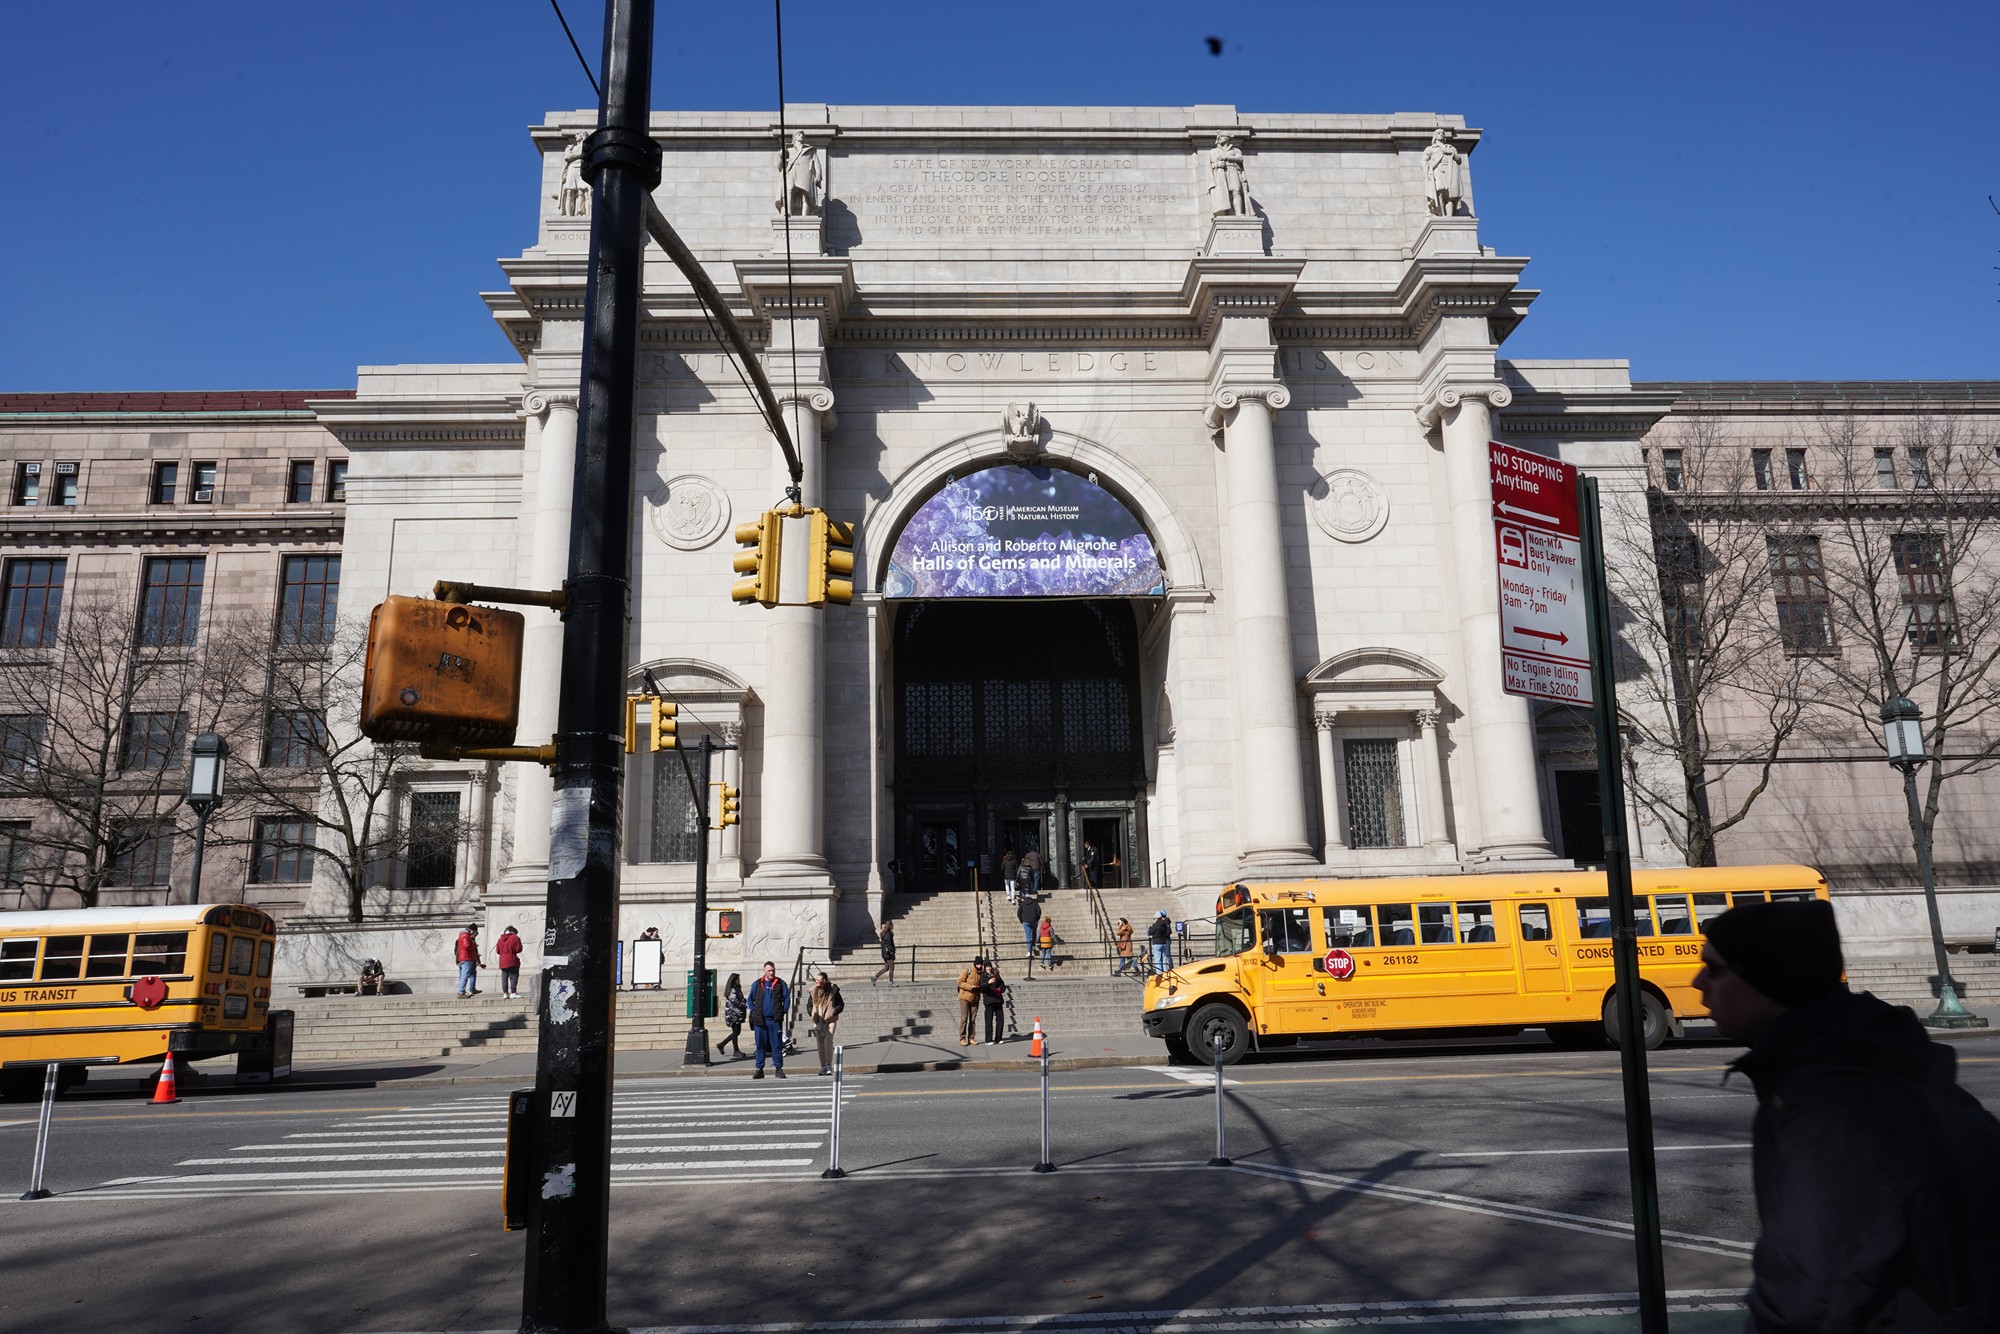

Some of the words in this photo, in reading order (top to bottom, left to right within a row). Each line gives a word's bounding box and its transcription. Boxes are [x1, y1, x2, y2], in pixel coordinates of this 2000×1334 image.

[893, 160, 932, 169] STATE
[939, 160, 954, 169] OF
[961, 160, 990, 169] NEW
[997, 160, 1032, 169] YORK
[1039, 160, 1110, 169] MEMORIAL
[1114, 160, 1132, 169] TO
[922, 171, 1009, 182] THEODORE
[1015, 171, 1104, 182] ROOSEVELT
[877, 185, 884, 193] A
[890, 185, 928, 193] GREAT
[934, 185, 976, 193] LEADER
[984, 185, 998, 193] OF
[1004, 185, 1026, 193] THE
[1032, 185, 1072, 193] YOUTH
[1078, 185, 1092, 193] OF
[1097, 185, 1149, 193] AMERICA
[850, 195, 861, 203] IN
[866, 195, 909, 203] ENERGY
[912, 195, 936, 203] AND
[941, 195, 1002, 203] FORTITUDE
[1008, 195, 1018, 203] IN
[1024, 195, 1044, 203] THE
[1048, 195, 1079, 203] FAITH
[1084, 195, 1098, 203] OF
[1103, 195, 1125, 203] OUR
[1131, 195, 1177, 203] FATHERS
[885, 205, 897, 214] IN
[904, 205, 953, 214] DEFENSE
[958, 205, 973, 214] OF
[978, 205, 1000, 214] THE
[1006, 205, 1048, 214] RIGHTS
[1054, 205, 1067, 214] OF
[1073, 205, 1095, 214] THE
[1101, 205, 1142, 214] PEOPLE
[875, 216, 887, 224] IN
[893, 216, 915, 224] THE
[921, 216, 951, 224] LOVE
[956, 216, 981, 224] AND
[987, 216, 1079, 224] CONSERVATION
[1085, 216, 1099, 224] OF
[1106, 216, 1153, 224] NATURE
[897, 226, 923, 235] AND
[928, 226, 943, 235] OF
[949, 226, 971, 235] THE
[977, 226, 1004, 235] BEST
[1009, 226, 1021, 235] IN
[1028, 226, 1051, 235] LIFE
[1056, 226, 1082, 235] AND
[1087, 226, 1099, 235] IN
[1105, 226, 1131, 235] MAN
[884, 352, 1158, 373] KNOWLEDGE
[1493, 450, 1509, 468] NO
[1512, 456, 1564, 483] STOPPING
[1495, 470, 1540, 494] Anytime
[930, 540, 974, 552] Allison
[977, 540, 1001, 552] and
[1005, 540, 1056, 552] Roberto
[1060, 540, 1117, 554] Mignone
[1528, 533, 1563, 551] Non-MTA
[912, 555, 954, 571] Halls
[957, 555, 976, 570] of
[979, 556, 1026, 570] Gems
[1029, 554, 1060, 570] and
[1065, 553, 1137, 570] Minerals
[1529, 547, 1544, 558] Bus
[1546, 550, 1576, 566] Layover
[1531, 563, 1551, 577] Only
[1502, 578, 1535, 598] Monday
[1542, 587, 1567, 606] Friday
[1503, 594, 1522, 608] 9am
[1529, 599, 1548, 614] 7pm
[1507, 658, 1519, 671] No
[1522, 660, 1552, 678] Engine
[1554, 666, 1579, 684] Idling
[1508, 675, 1526, 689] Max
[1529, 678, 1547, 692] Fine
[1550, 681, 1579, 698] $2000
[1577, 945, 1665, 960] CONSOATED
[1675, 944, 1698, 956] BUS
[1328, 958, 1349, 969] STOP
[1383, 955, 1419, 966] 261182
[1, 991, 17, 1002] US
[23, 989, 78, 1001] TRANSIT
